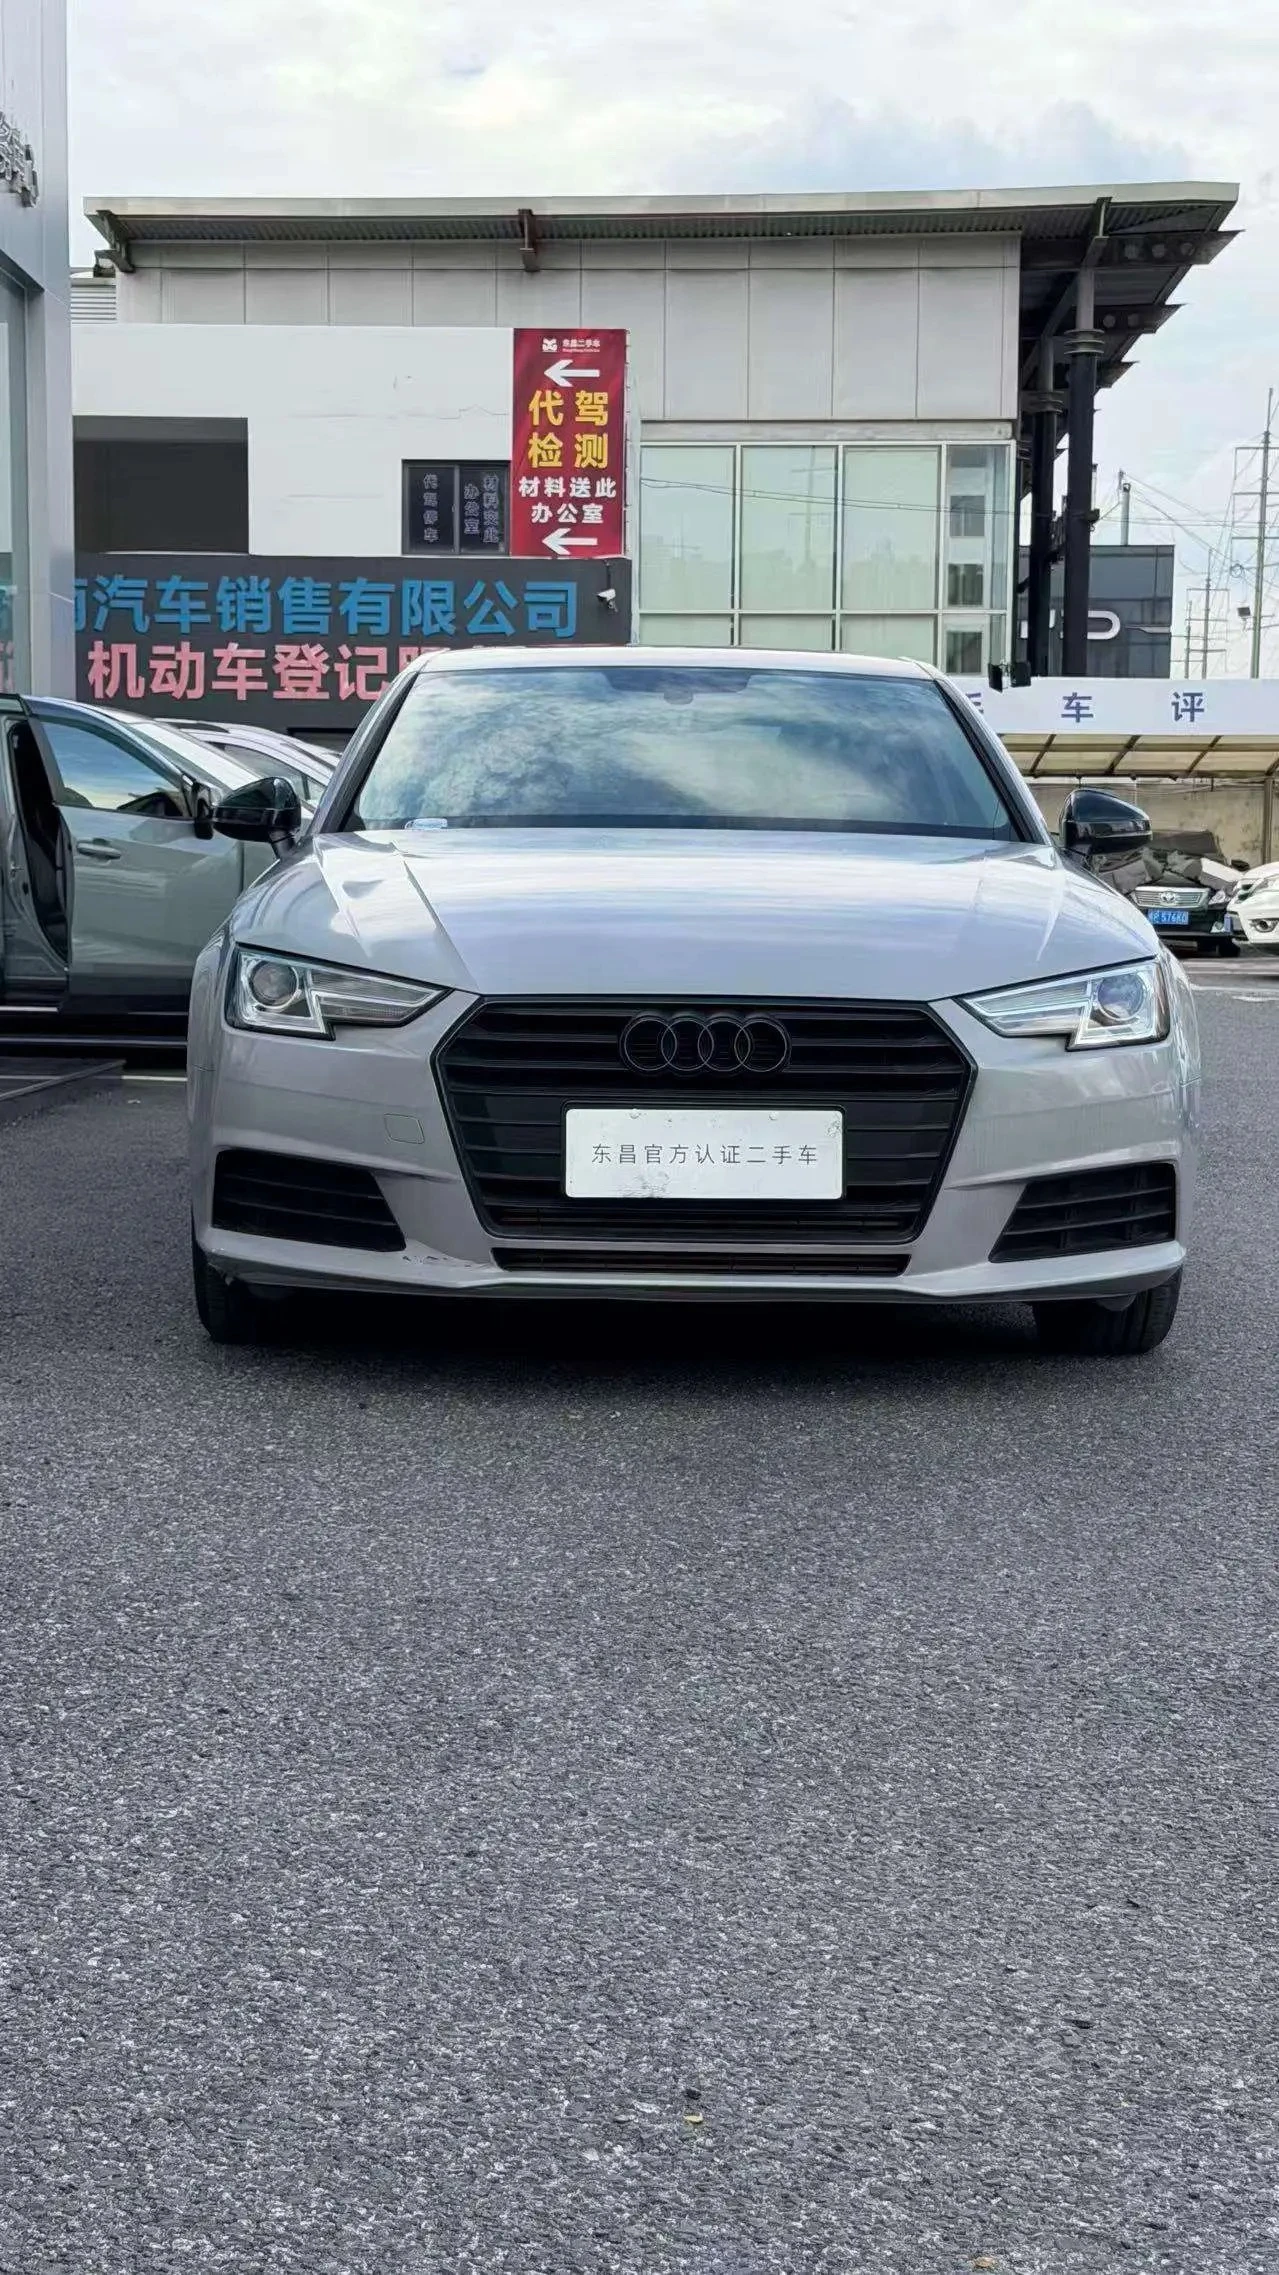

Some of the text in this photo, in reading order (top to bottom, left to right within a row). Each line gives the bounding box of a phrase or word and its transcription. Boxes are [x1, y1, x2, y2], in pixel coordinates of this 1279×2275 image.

[528, 390, 609, 426] 代驾
[527, 432, 609, 469] 检测
[518, 476, 616, 498] 材料送此
[531, 503, 604, 524] 办公室
[965, 691, 1205, 723] 车评
[591, 1143, 818, 1165] 东昌官方认证二手车
